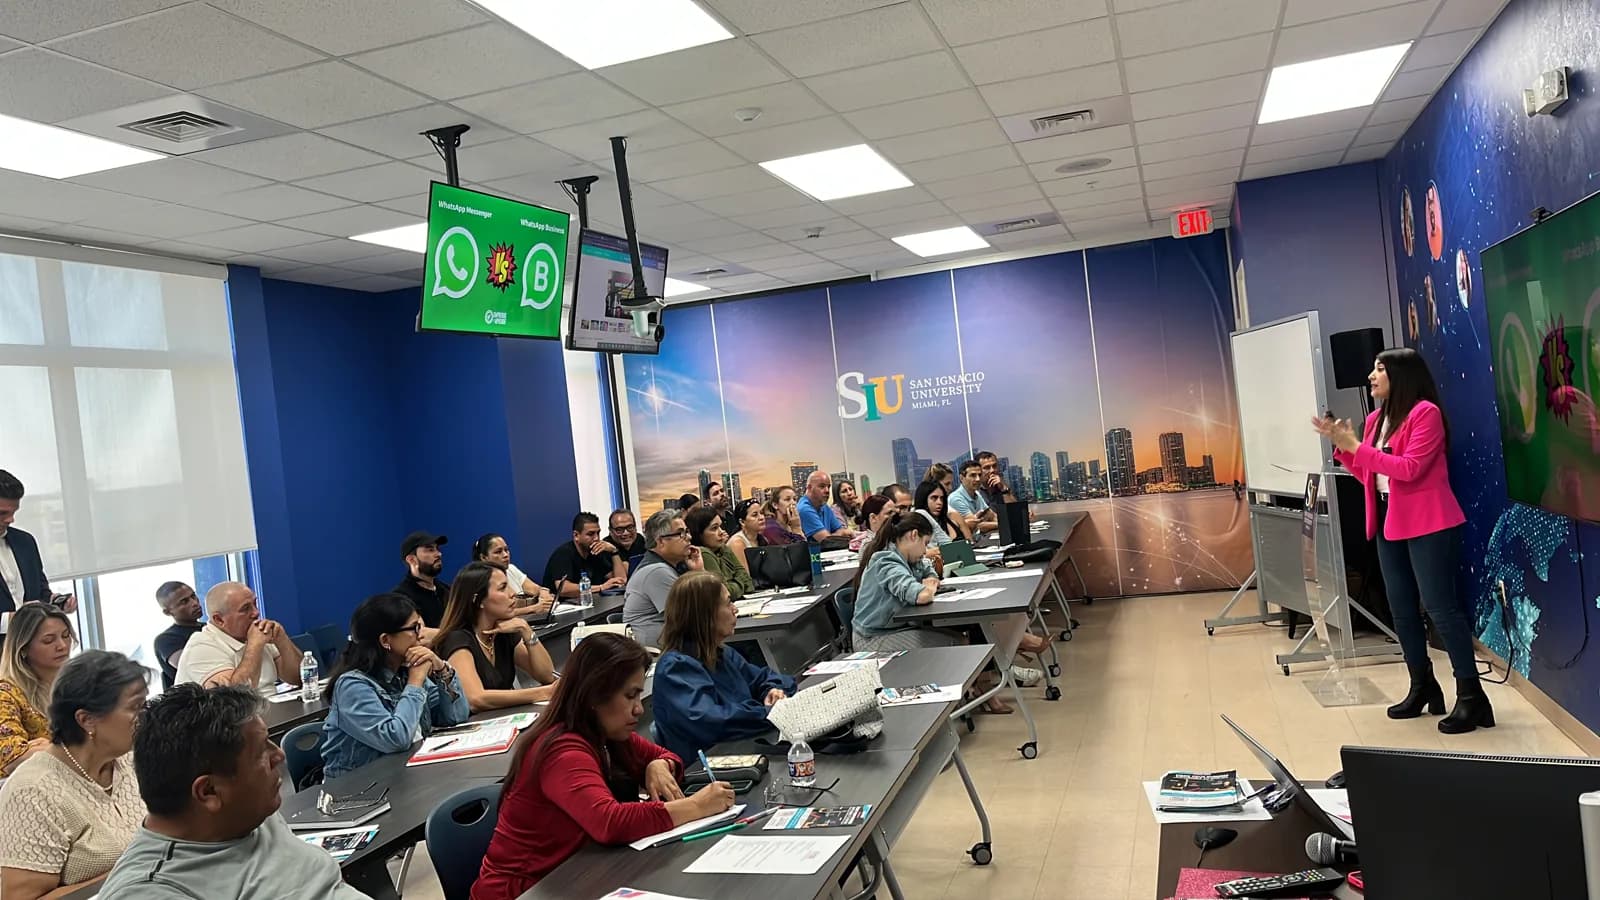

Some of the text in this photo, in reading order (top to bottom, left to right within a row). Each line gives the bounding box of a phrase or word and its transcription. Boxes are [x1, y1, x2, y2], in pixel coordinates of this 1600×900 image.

[438, 201, 493, 219] WhatsApp Messenger
[520, 219, 565, 234] WhatsApp Business
[1178, 210, 1207, 236] EXIT
[534, 260, 549, 291] B
[909, 371, 985, 390] SAN IGNACIO
[836, 371, 905, 421] SIU
[911, 383, 982, 400] UNIVERSITY
[911, 399, 952, 410] MIAMI, FL
